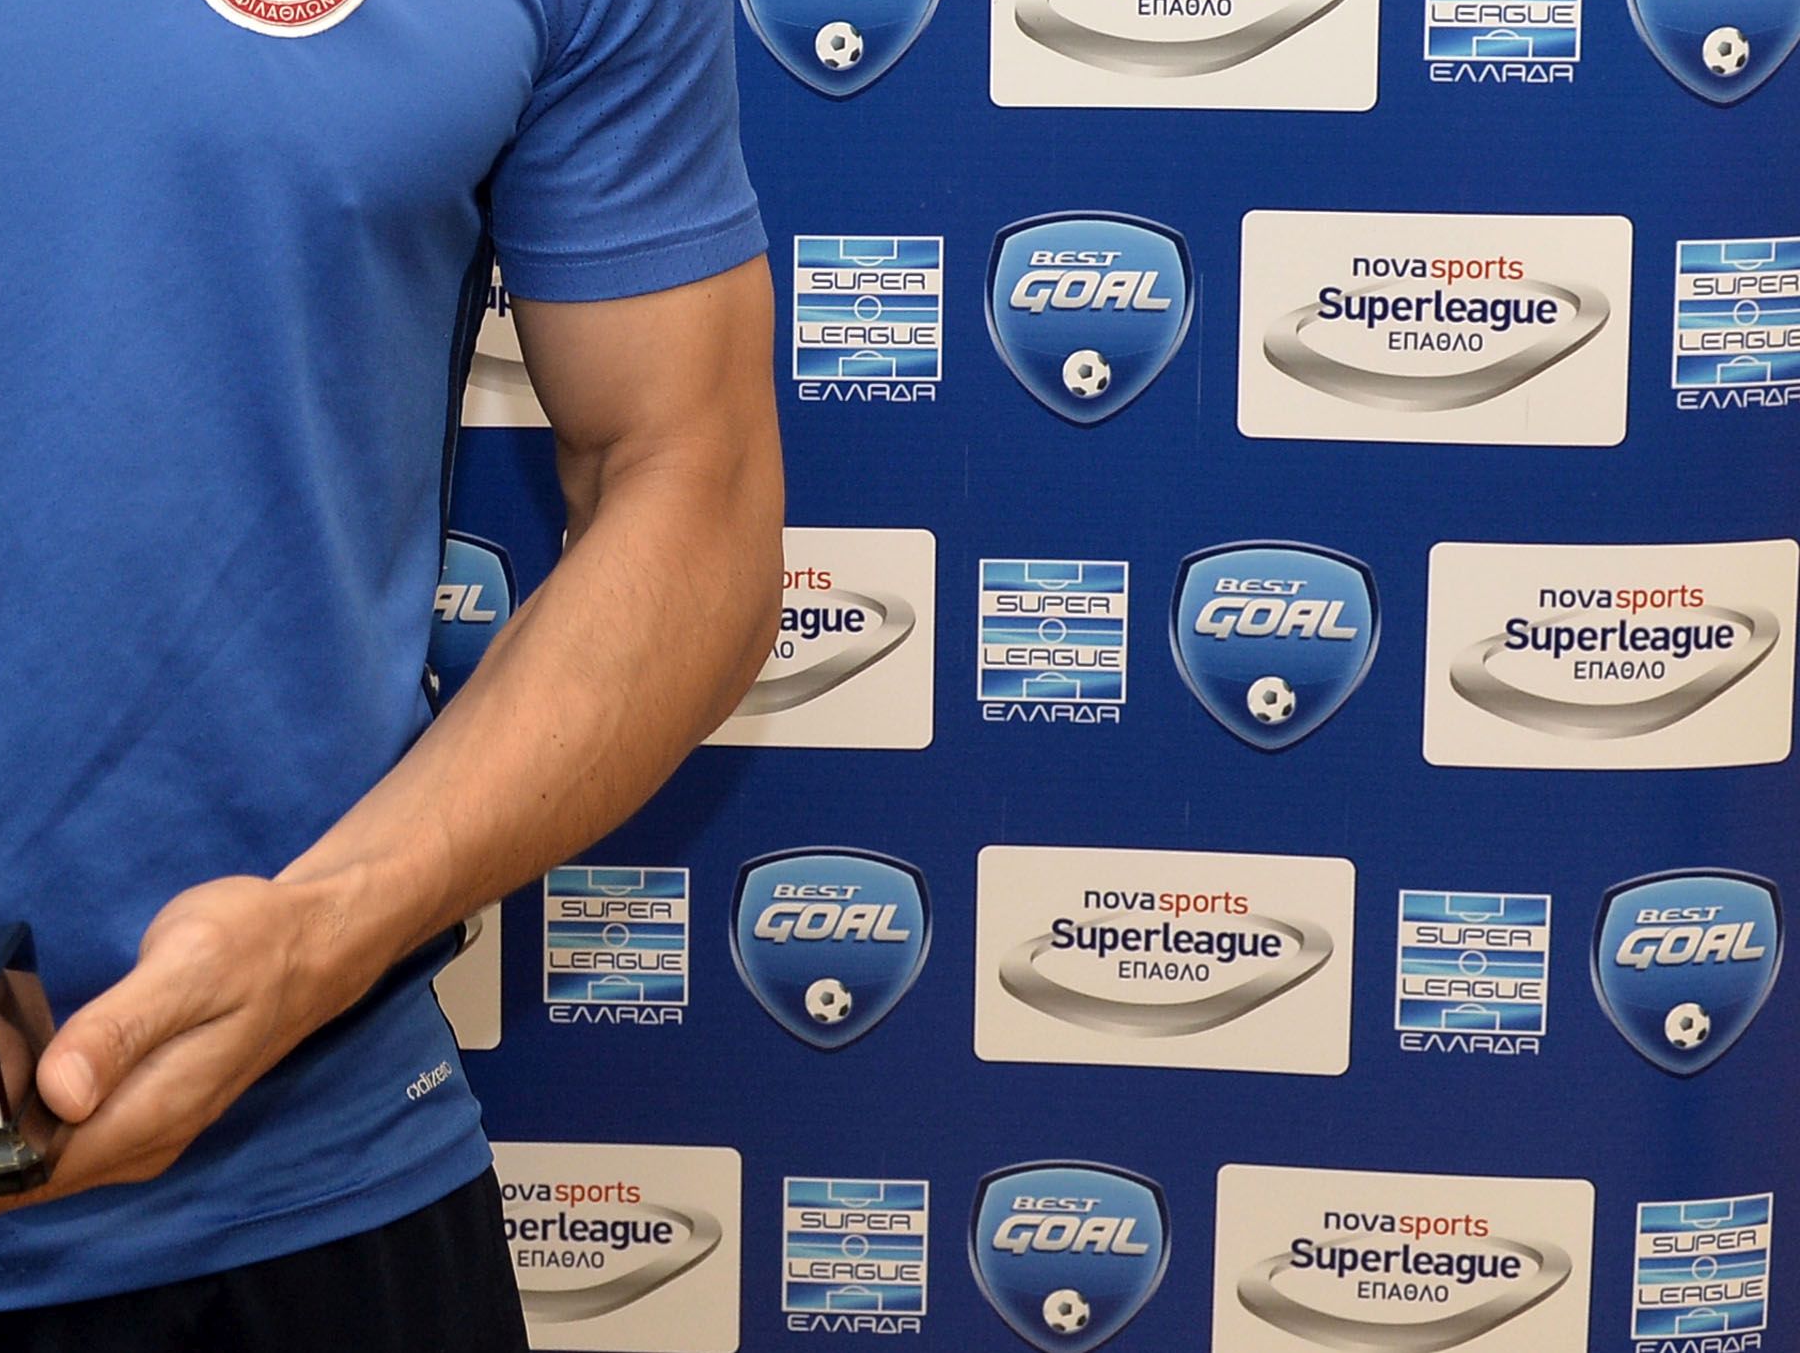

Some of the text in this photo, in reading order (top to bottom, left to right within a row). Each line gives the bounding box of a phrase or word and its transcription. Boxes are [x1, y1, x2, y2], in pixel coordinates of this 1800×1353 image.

[1432, 5, 1574, 23] LEAGUE
[812, 272, 925, 290] SUPER
[1353, 257, 1523, 285] novasports
[1010, 268, 1172, 311] GOAL
[1318, 288, 1557, 331] Superleague
[800, 326, 935, 344] LEAGUE
[1389, 332, 1482, 351] ΕΠΑΘΛΟ
[1215, 577, 1308, 595] BEST
[997, 595, 1110, 613] SUPER
[1540, 585, 1703, 614] novasports
[1195, 595, 1358, 638] GOAL
[1505, 614, 1735, 658] Superleague
[984, 648, 1120, 667] LEAGUE
[1574, 661, 1665, 679] ΕΠΑΘΛΟ
[561, 900, 671, 918] SUPER
[1085, 891, 1248, 918] novasports
[754, 900, 911, 942] GOAL
[1051, 919, 1281, 962] Superleague
[1416, 927, 1531, 946] SUPER
[1615, 922, 1769, 968] GOAL
[550, 951, 681, 970] LEAGUE
[1119, 961, 1209, 981] ΕΠΑΘΛΟ
[1403, 978, 1540, 999] LEAGUE
[1012, 1195, 1102, 1212] BEST
[801, 1212, 910, 1230] SUPER
[1325, 1212, 1488, 1240] novasports
[993, 1212, 1149, 1253] GOAL
[1653, 1231, 1755, 1253] SUPER
[517, 1250, 604, 1268] ΕΠΑΘΛΟ
[1290, 1239, 1520, 1284] Superleague
[788, 1262, 920, 1281] LEAGUE
[1358, 1281, 1448, 1302] ΕΠΑΘΛΟ
[1640, 1281, 1762, 1305] LEAGUE
